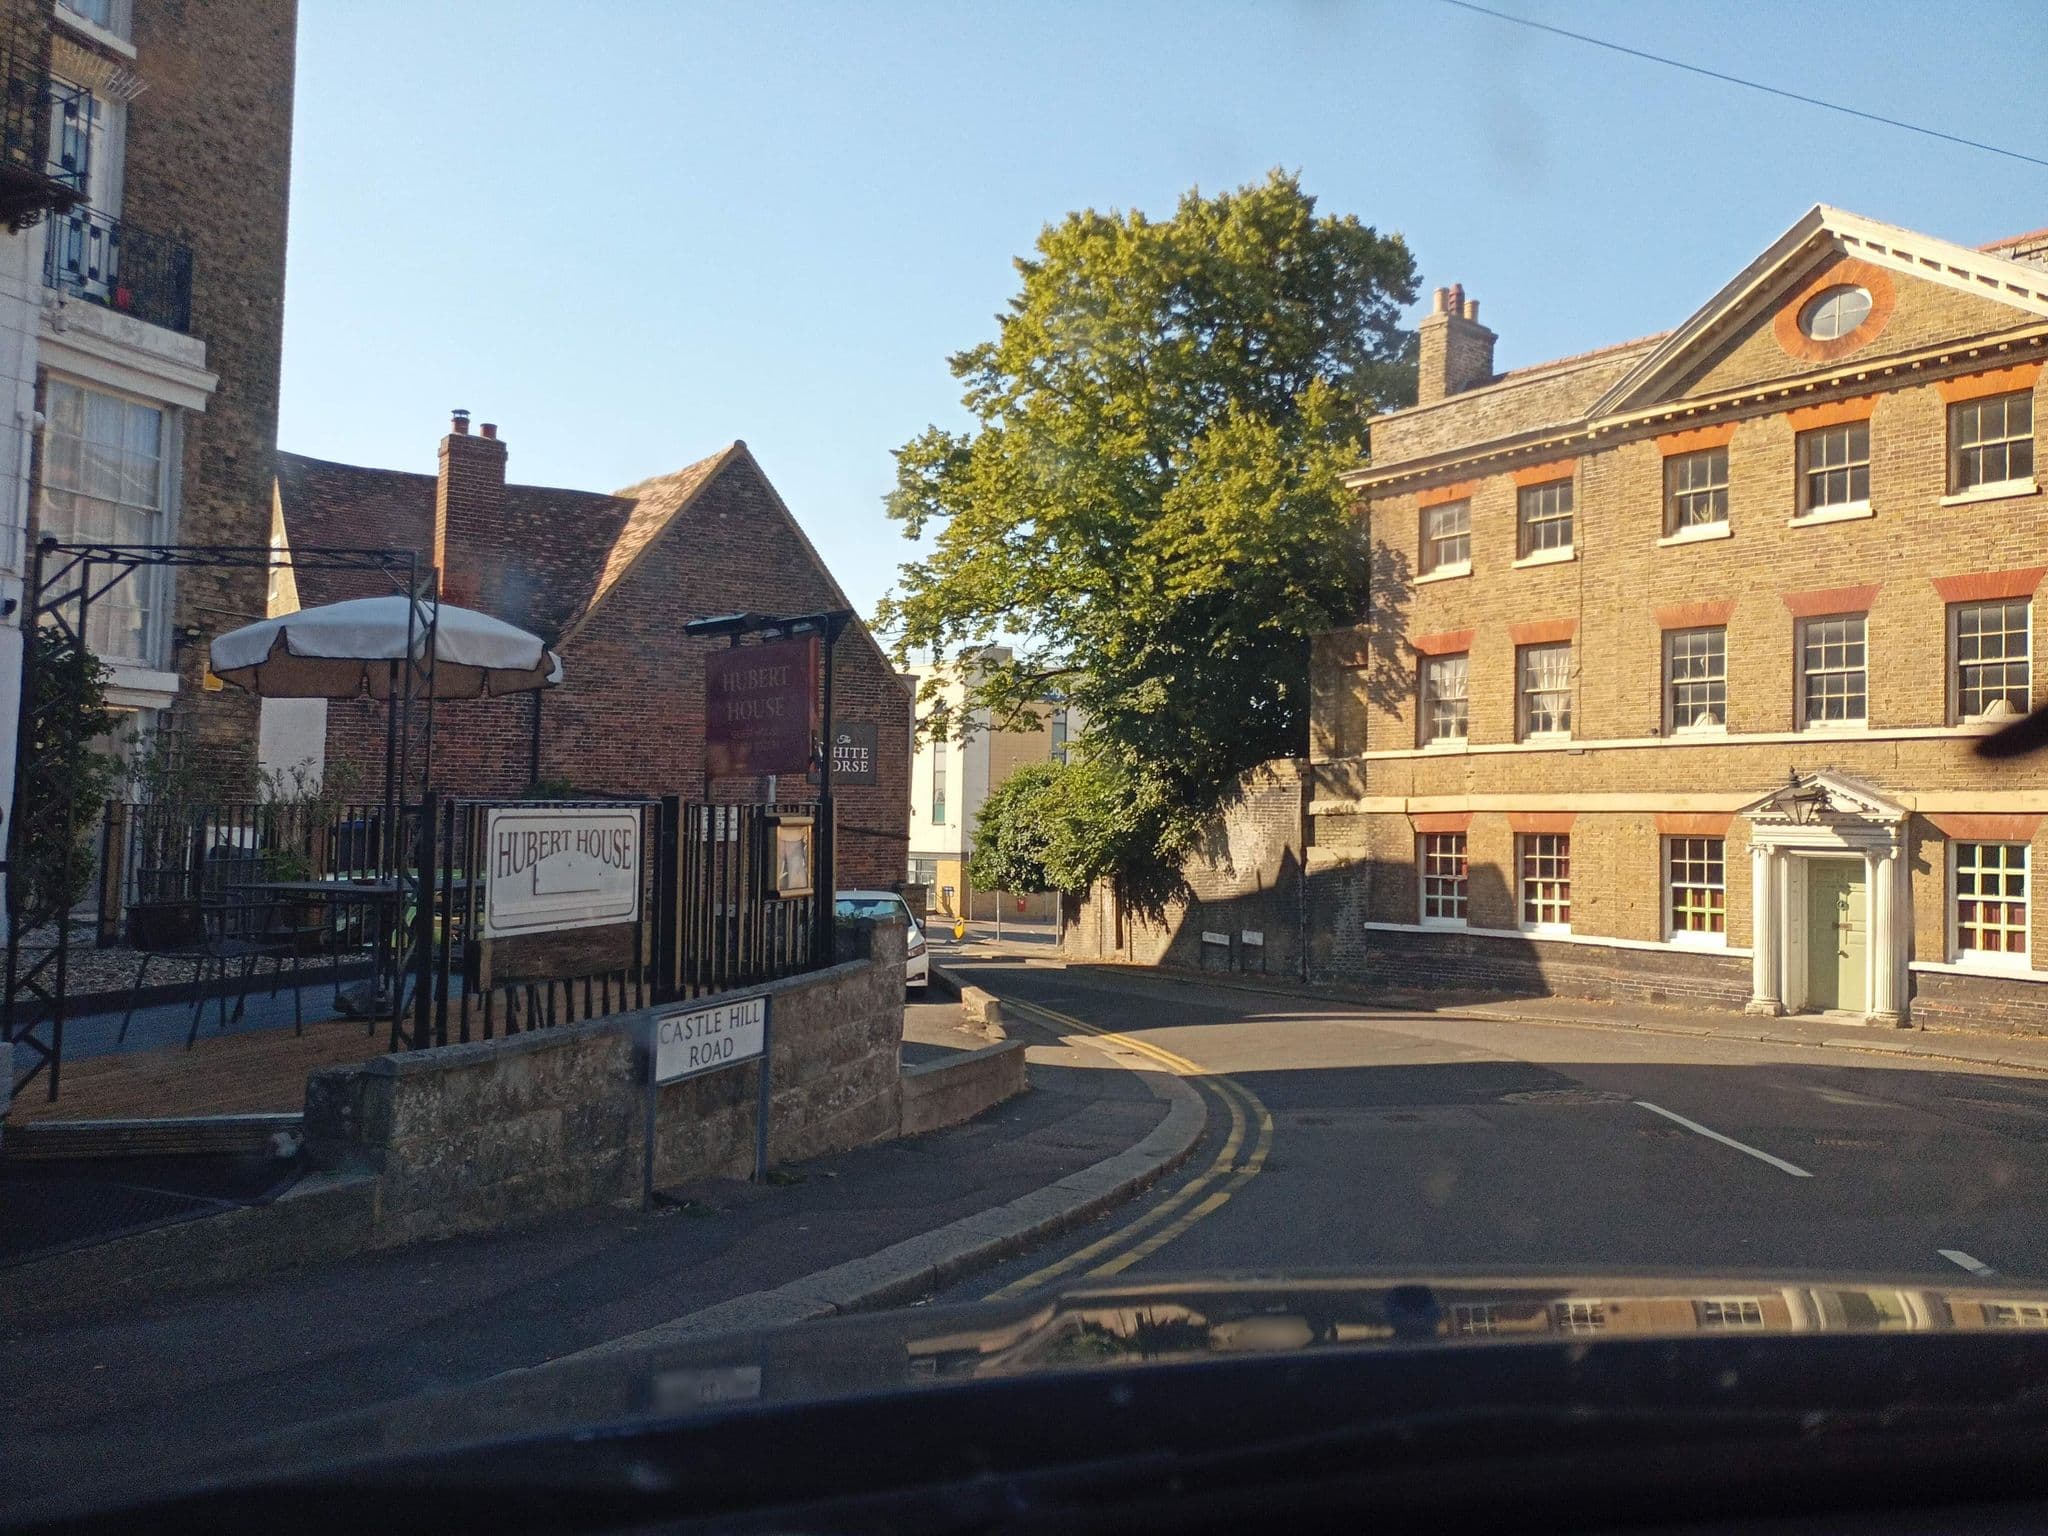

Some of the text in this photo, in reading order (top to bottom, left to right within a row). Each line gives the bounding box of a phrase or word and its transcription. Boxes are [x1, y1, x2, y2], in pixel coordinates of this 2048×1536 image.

[722, 665, 790, 692] HUBERT
[727, 696, 785, 721] HOUSE
[832, 746, 869, 759] HITE
[832, 761, 869, 773] ORSE
[497, 828, 632, 879] HUBERT HOUSE
[660, 1002, 760, 1045] CASTLE HILL
[689, 1037, 734, 1068] ROAD
